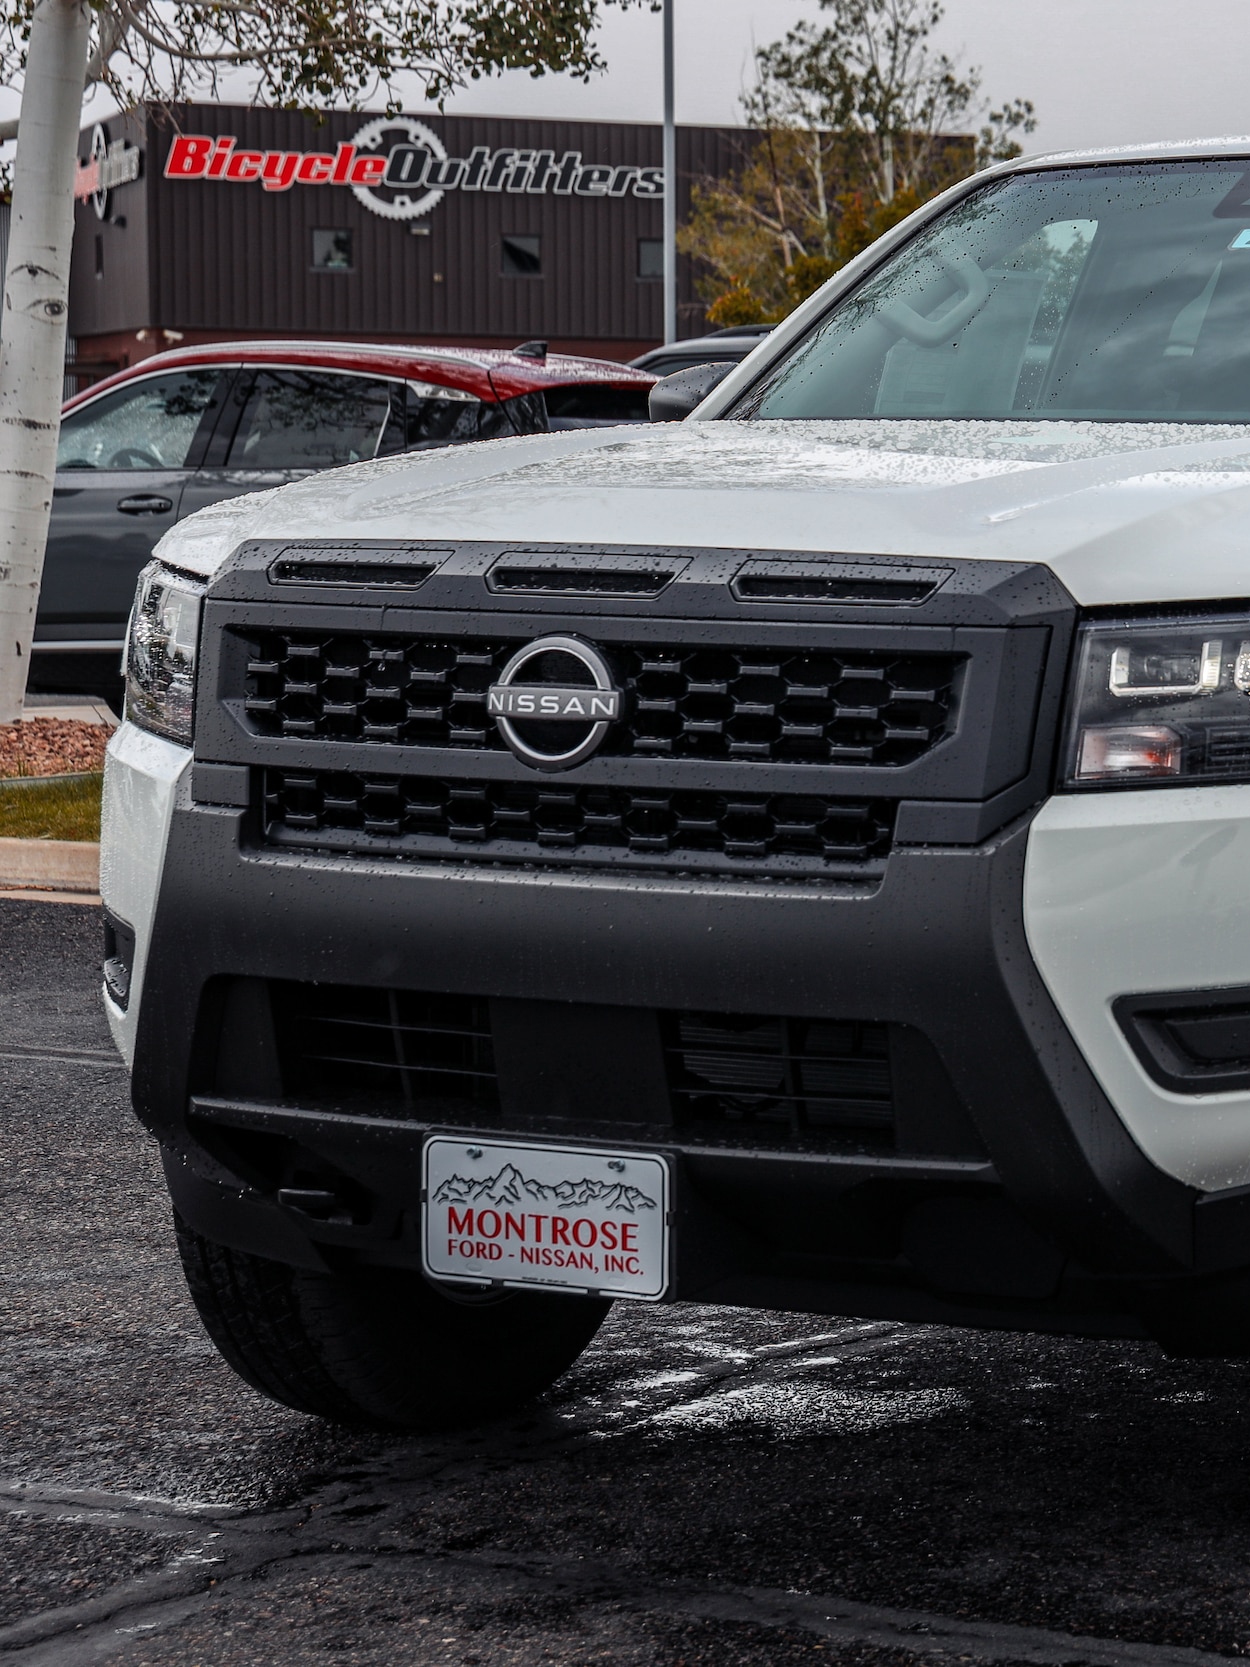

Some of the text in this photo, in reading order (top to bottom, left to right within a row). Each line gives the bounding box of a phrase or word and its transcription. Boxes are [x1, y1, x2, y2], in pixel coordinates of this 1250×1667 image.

[164, 133, 388, 191] Bicycle
[488, 692, 614, 716] NISSAN
[447, 1206, 639, 1253] MONTROSE
[447, 1238, 503, 1261] FORD
[520, 1246, 599, 1274] NISSAN,
[604, 1254, 644, 1276] INC.
